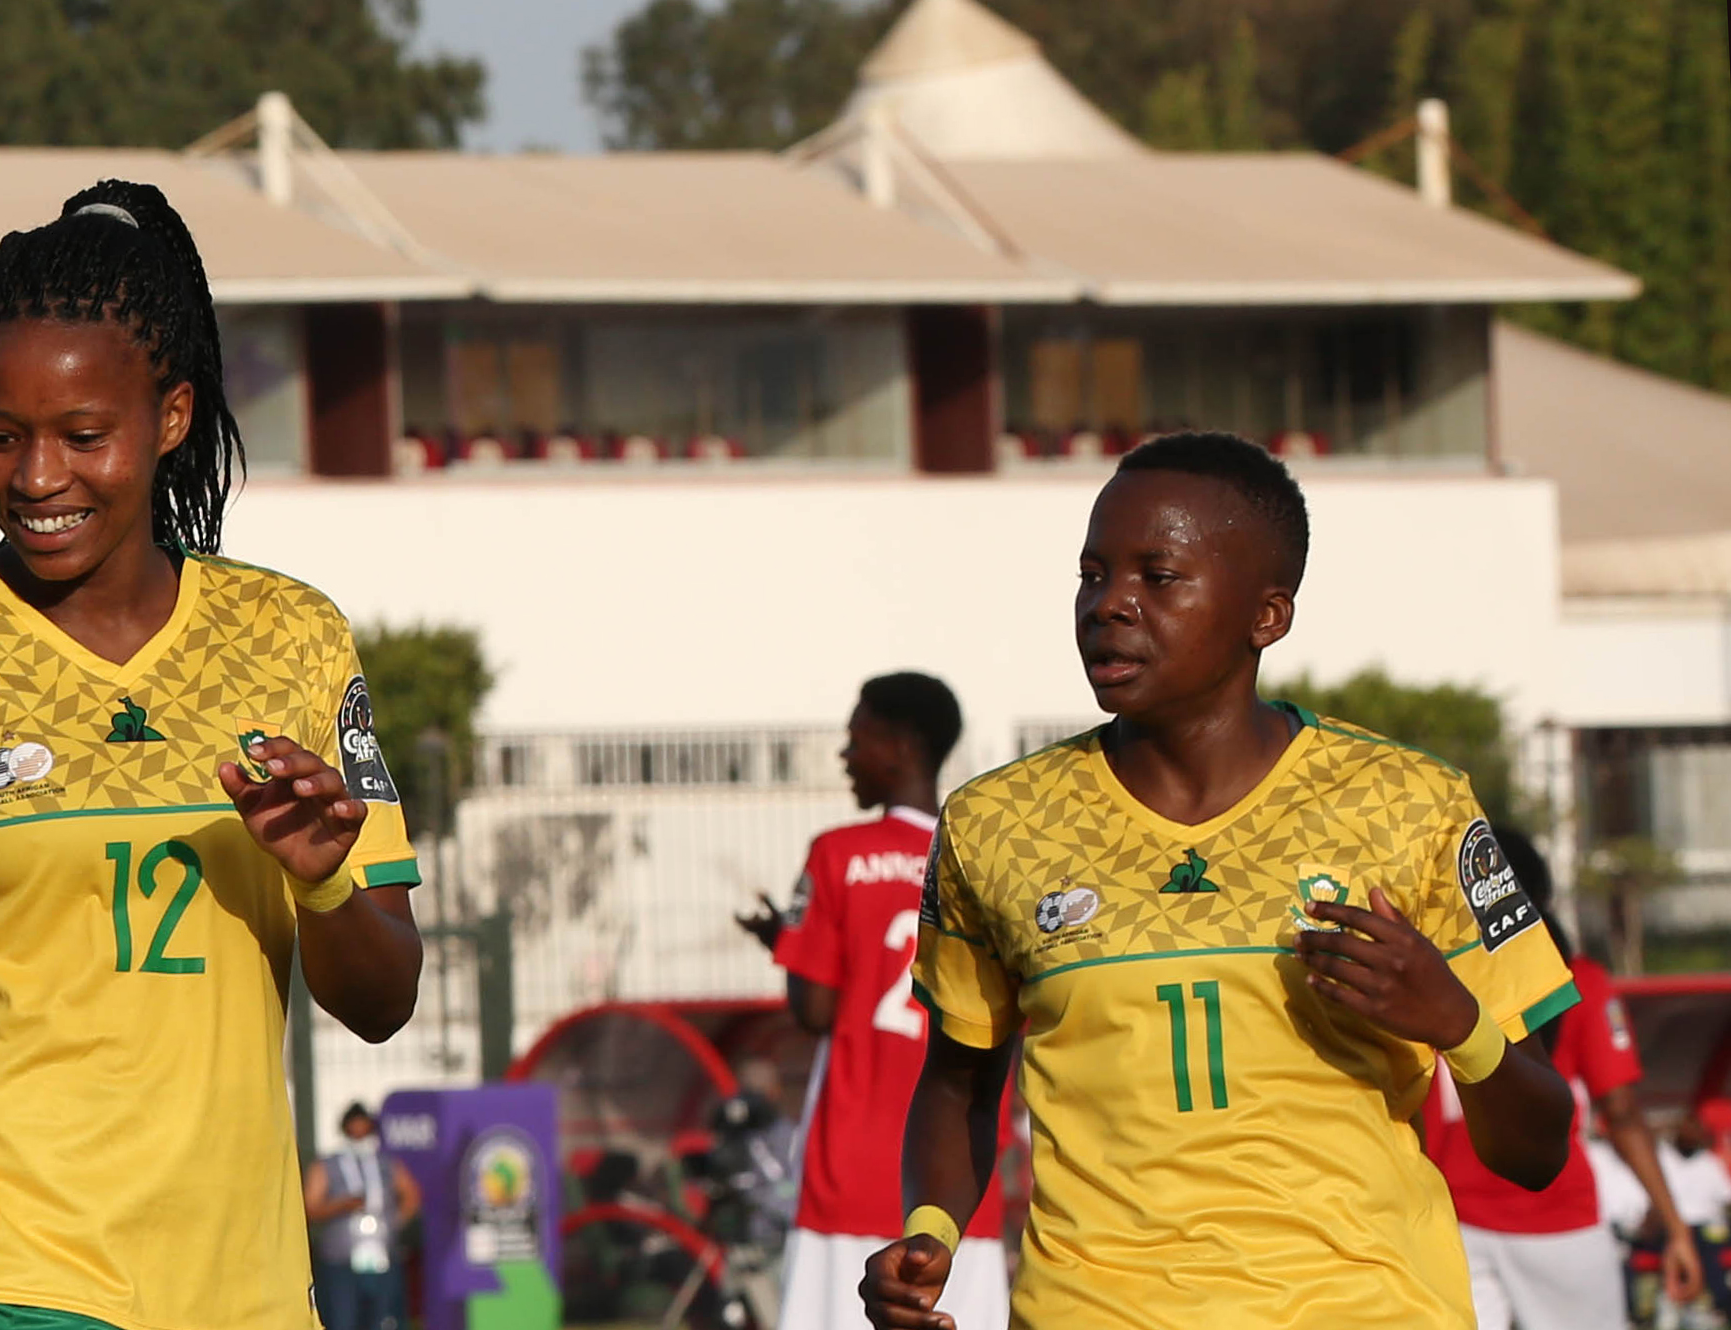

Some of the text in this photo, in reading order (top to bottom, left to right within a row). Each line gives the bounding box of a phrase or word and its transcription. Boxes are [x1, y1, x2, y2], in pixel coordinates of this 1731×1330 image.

[105, 839, 207, 974] 12
[1488, 904, 1529, 938] CAF
[1156, 980, 1228, 1112] 11
